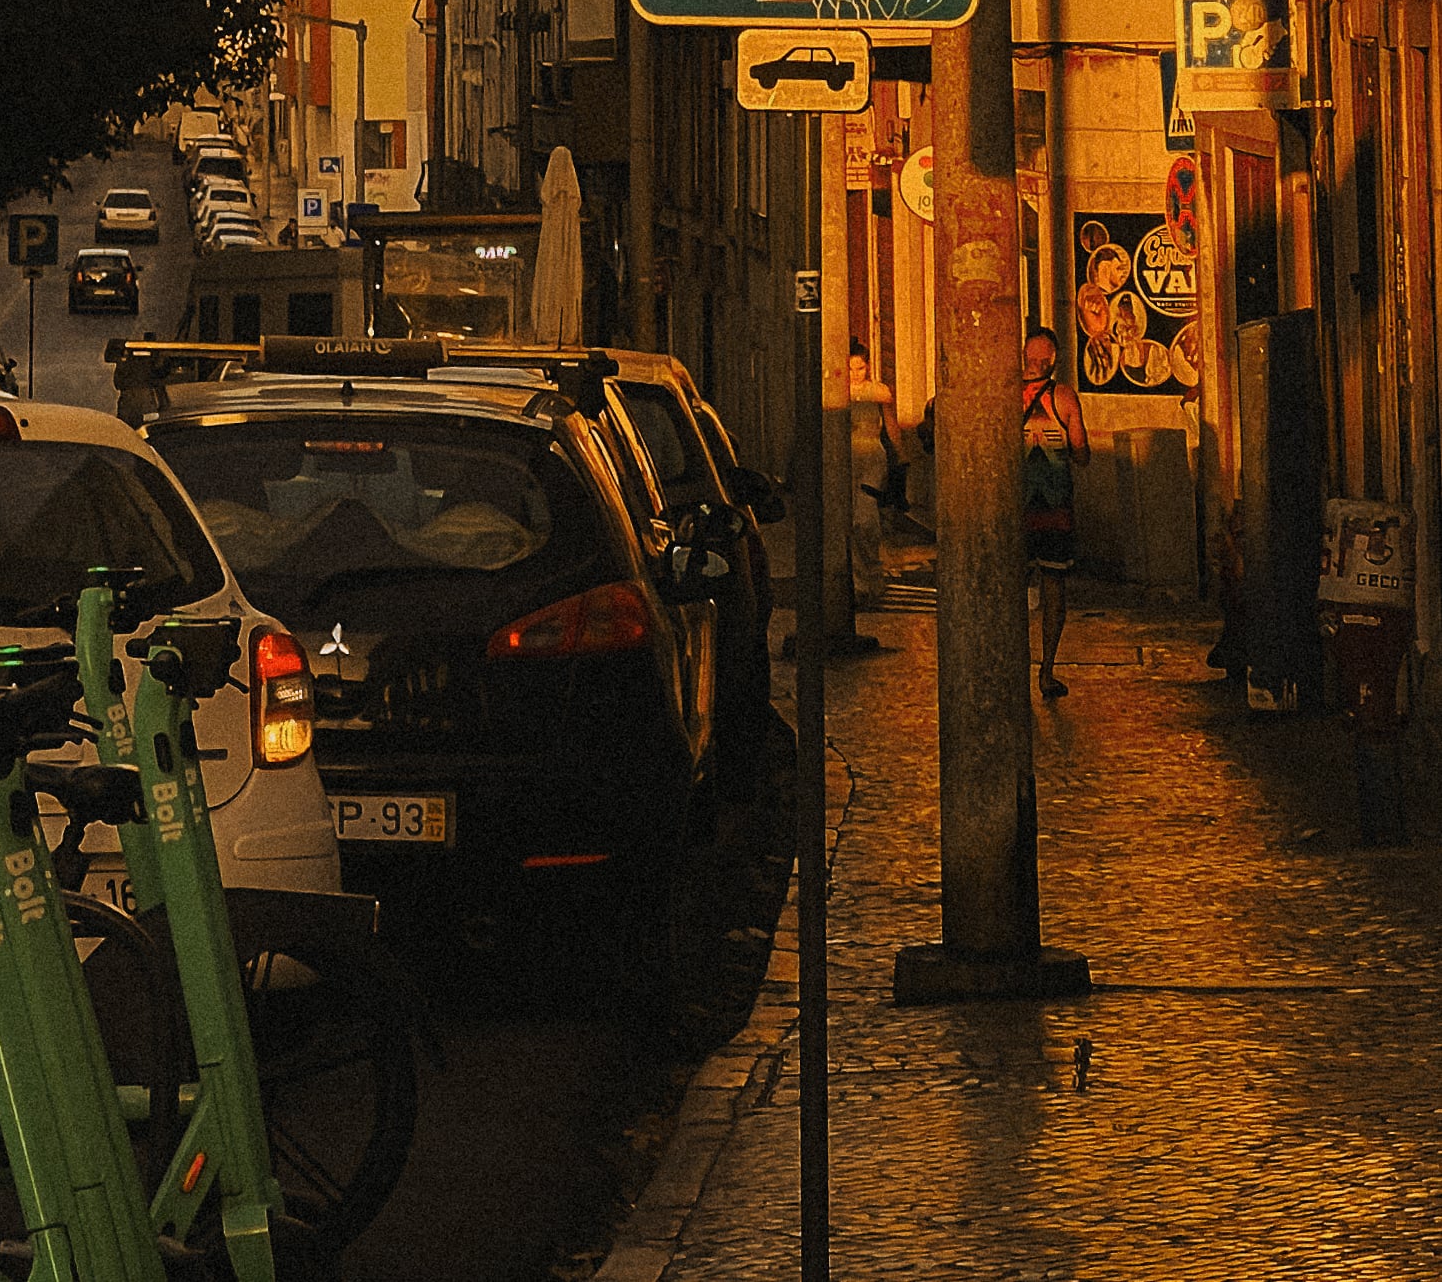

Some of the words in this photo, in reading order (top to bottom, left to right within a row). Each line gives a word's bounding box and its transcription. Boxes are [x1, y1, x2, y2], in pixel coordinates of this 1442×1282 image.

[1192, 1, 1233, 59] P
[306, 199, 318, 214] P
[18, 218, 48, 262] P
[151, 780, 185, 843] Bolt
[4, 847, 47, 926] Bolt
